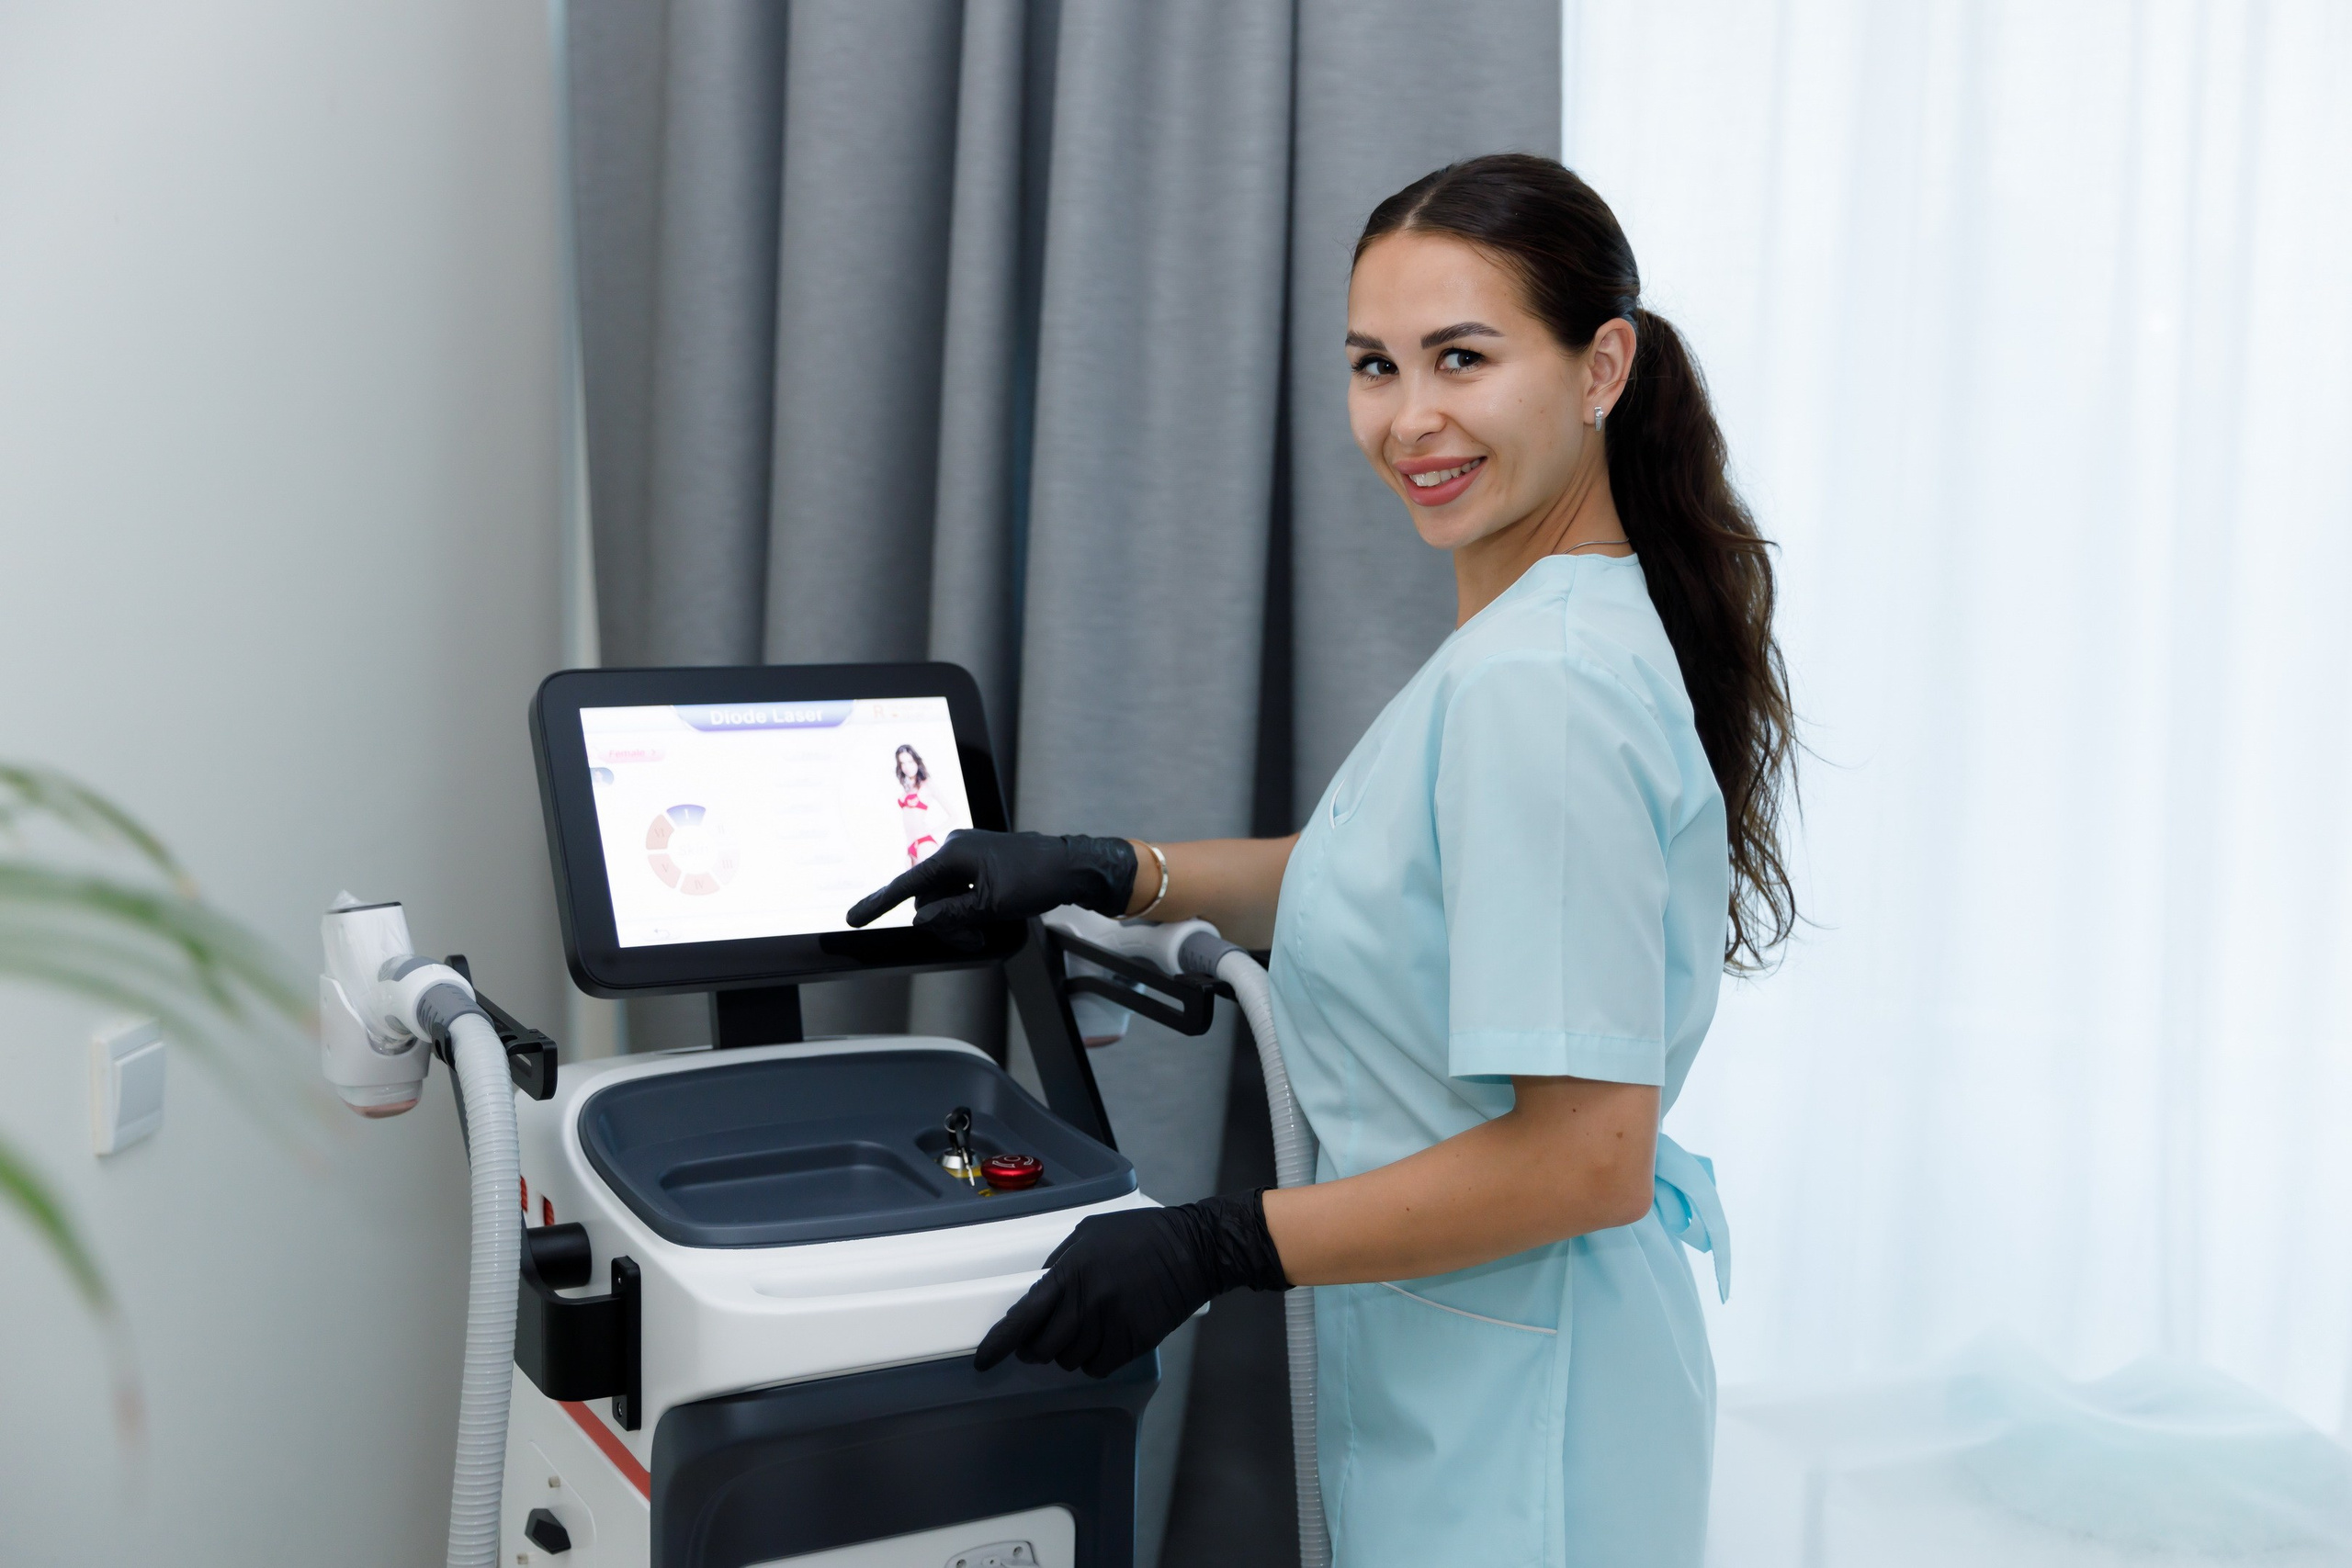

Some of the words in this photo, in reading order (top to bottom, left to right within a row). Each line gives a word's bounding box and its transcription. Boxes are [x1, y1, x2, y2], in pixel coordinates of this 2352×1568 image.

[709, 708, 767, 726] Diode
[772, 707, 824, 724] Laser
[608, 748, 646, 759] Female
